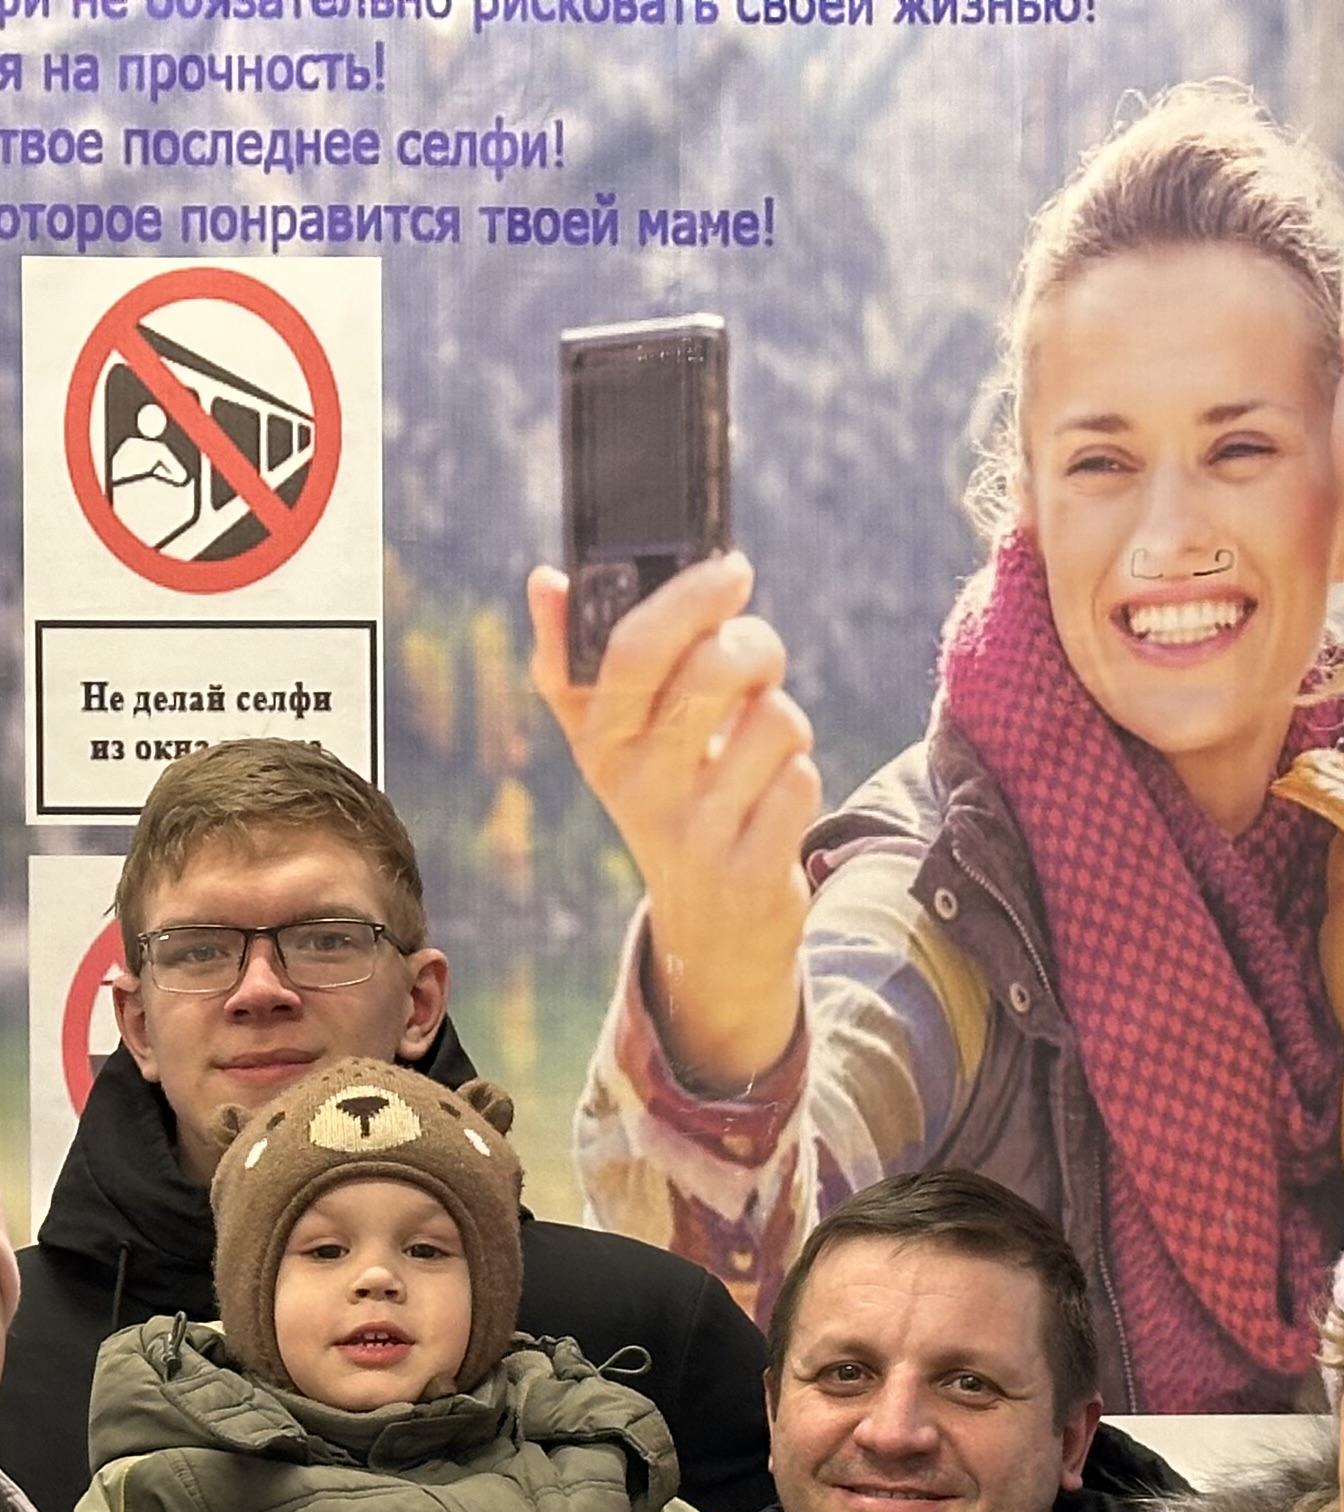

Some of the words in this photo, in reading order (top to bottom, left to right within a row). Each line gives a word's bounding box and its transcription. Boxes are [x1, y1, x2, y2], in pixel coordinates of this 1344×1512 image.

[44, 53, 100, 92] на
[119, 41, 386, 103] прочность!
[124, 128, 381, 175] последнее
[397, 115, 564, 182] селфи!
[181, 203, 460, 254] понравится
[479, 192, 619, 246] твоей
[638, 197, 775, 247] маме!
[80, 681, 125, 712] Не
[133, 683, 226, 719] делай
[236, 681, 333, 720] селфи
[90, 739, 126, 761] из
